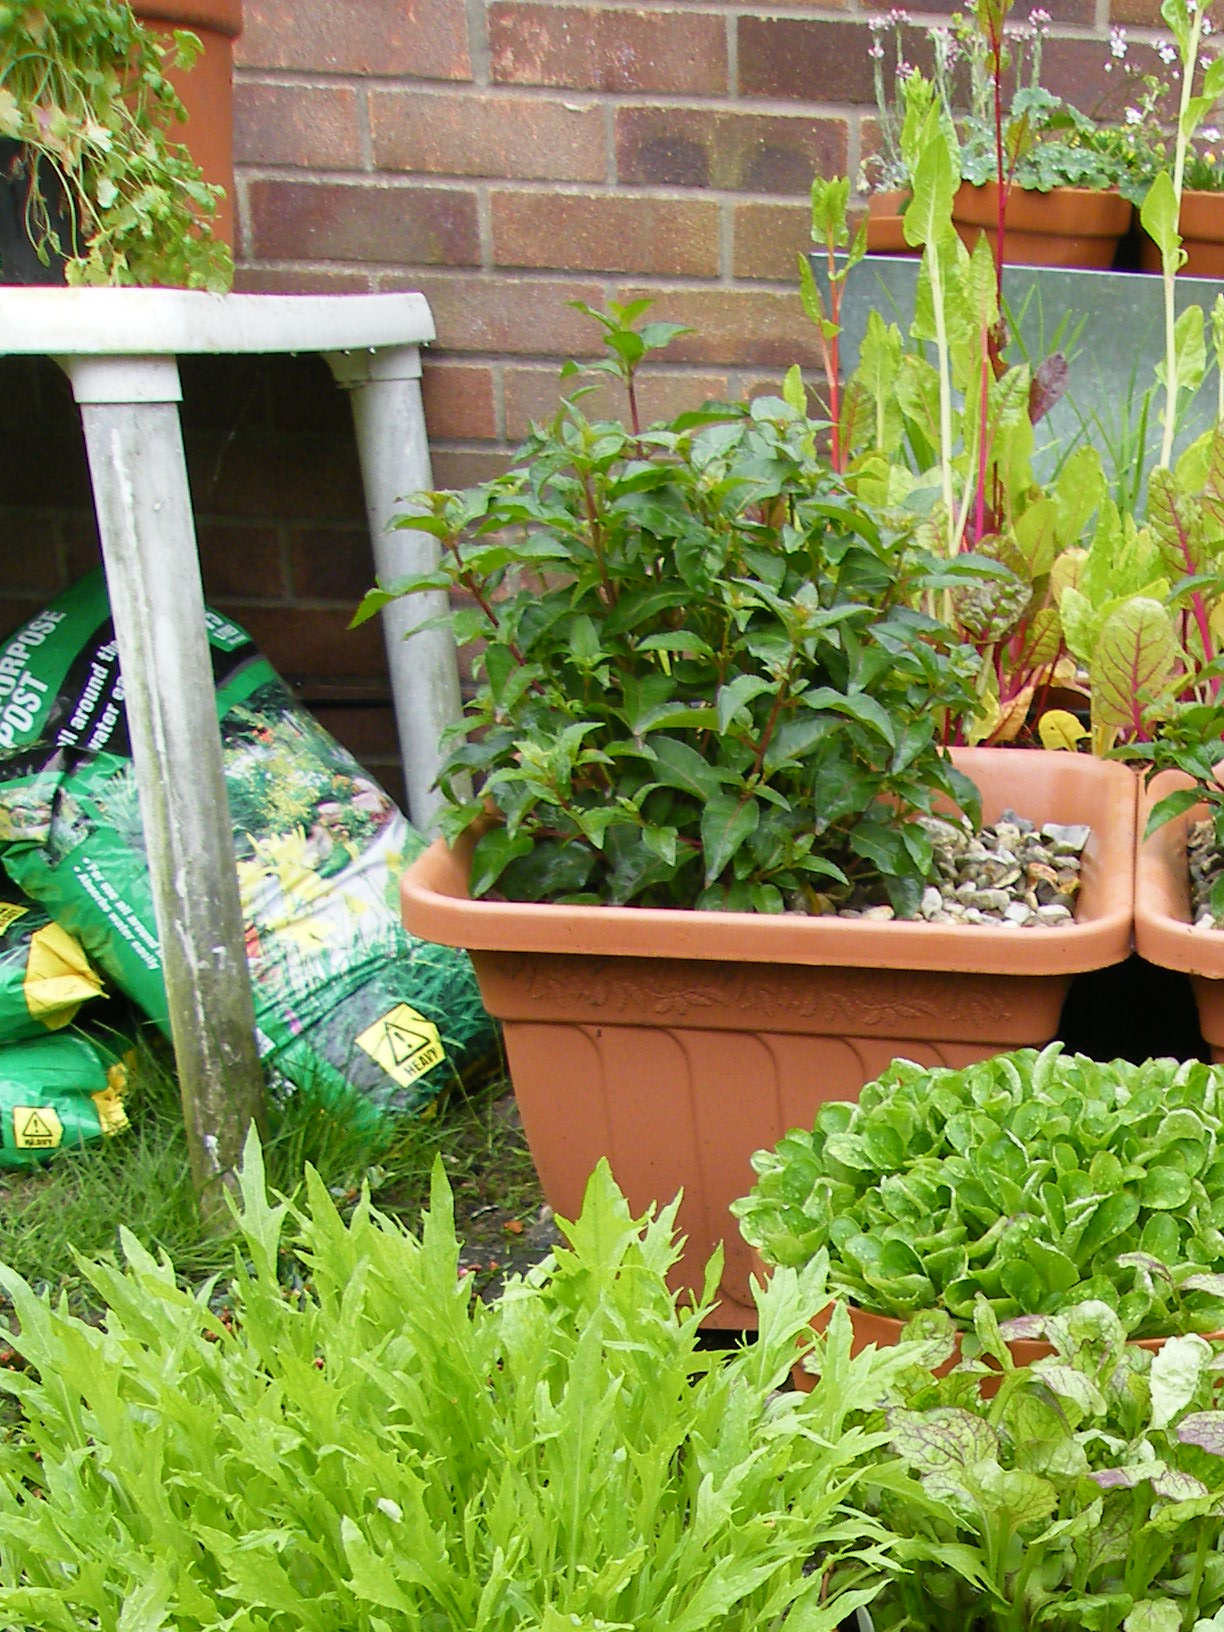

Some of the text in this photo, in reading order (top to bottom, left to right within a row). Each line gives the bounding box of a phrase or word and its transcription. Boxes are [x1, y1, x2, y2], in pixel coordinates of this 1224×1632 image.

[0, 610, 67, 704] URPOSE
[0, 671, 49, 749] POST
[70, 661, 109, 731] around
[403, 1046, 438, 1076] HEAVY
